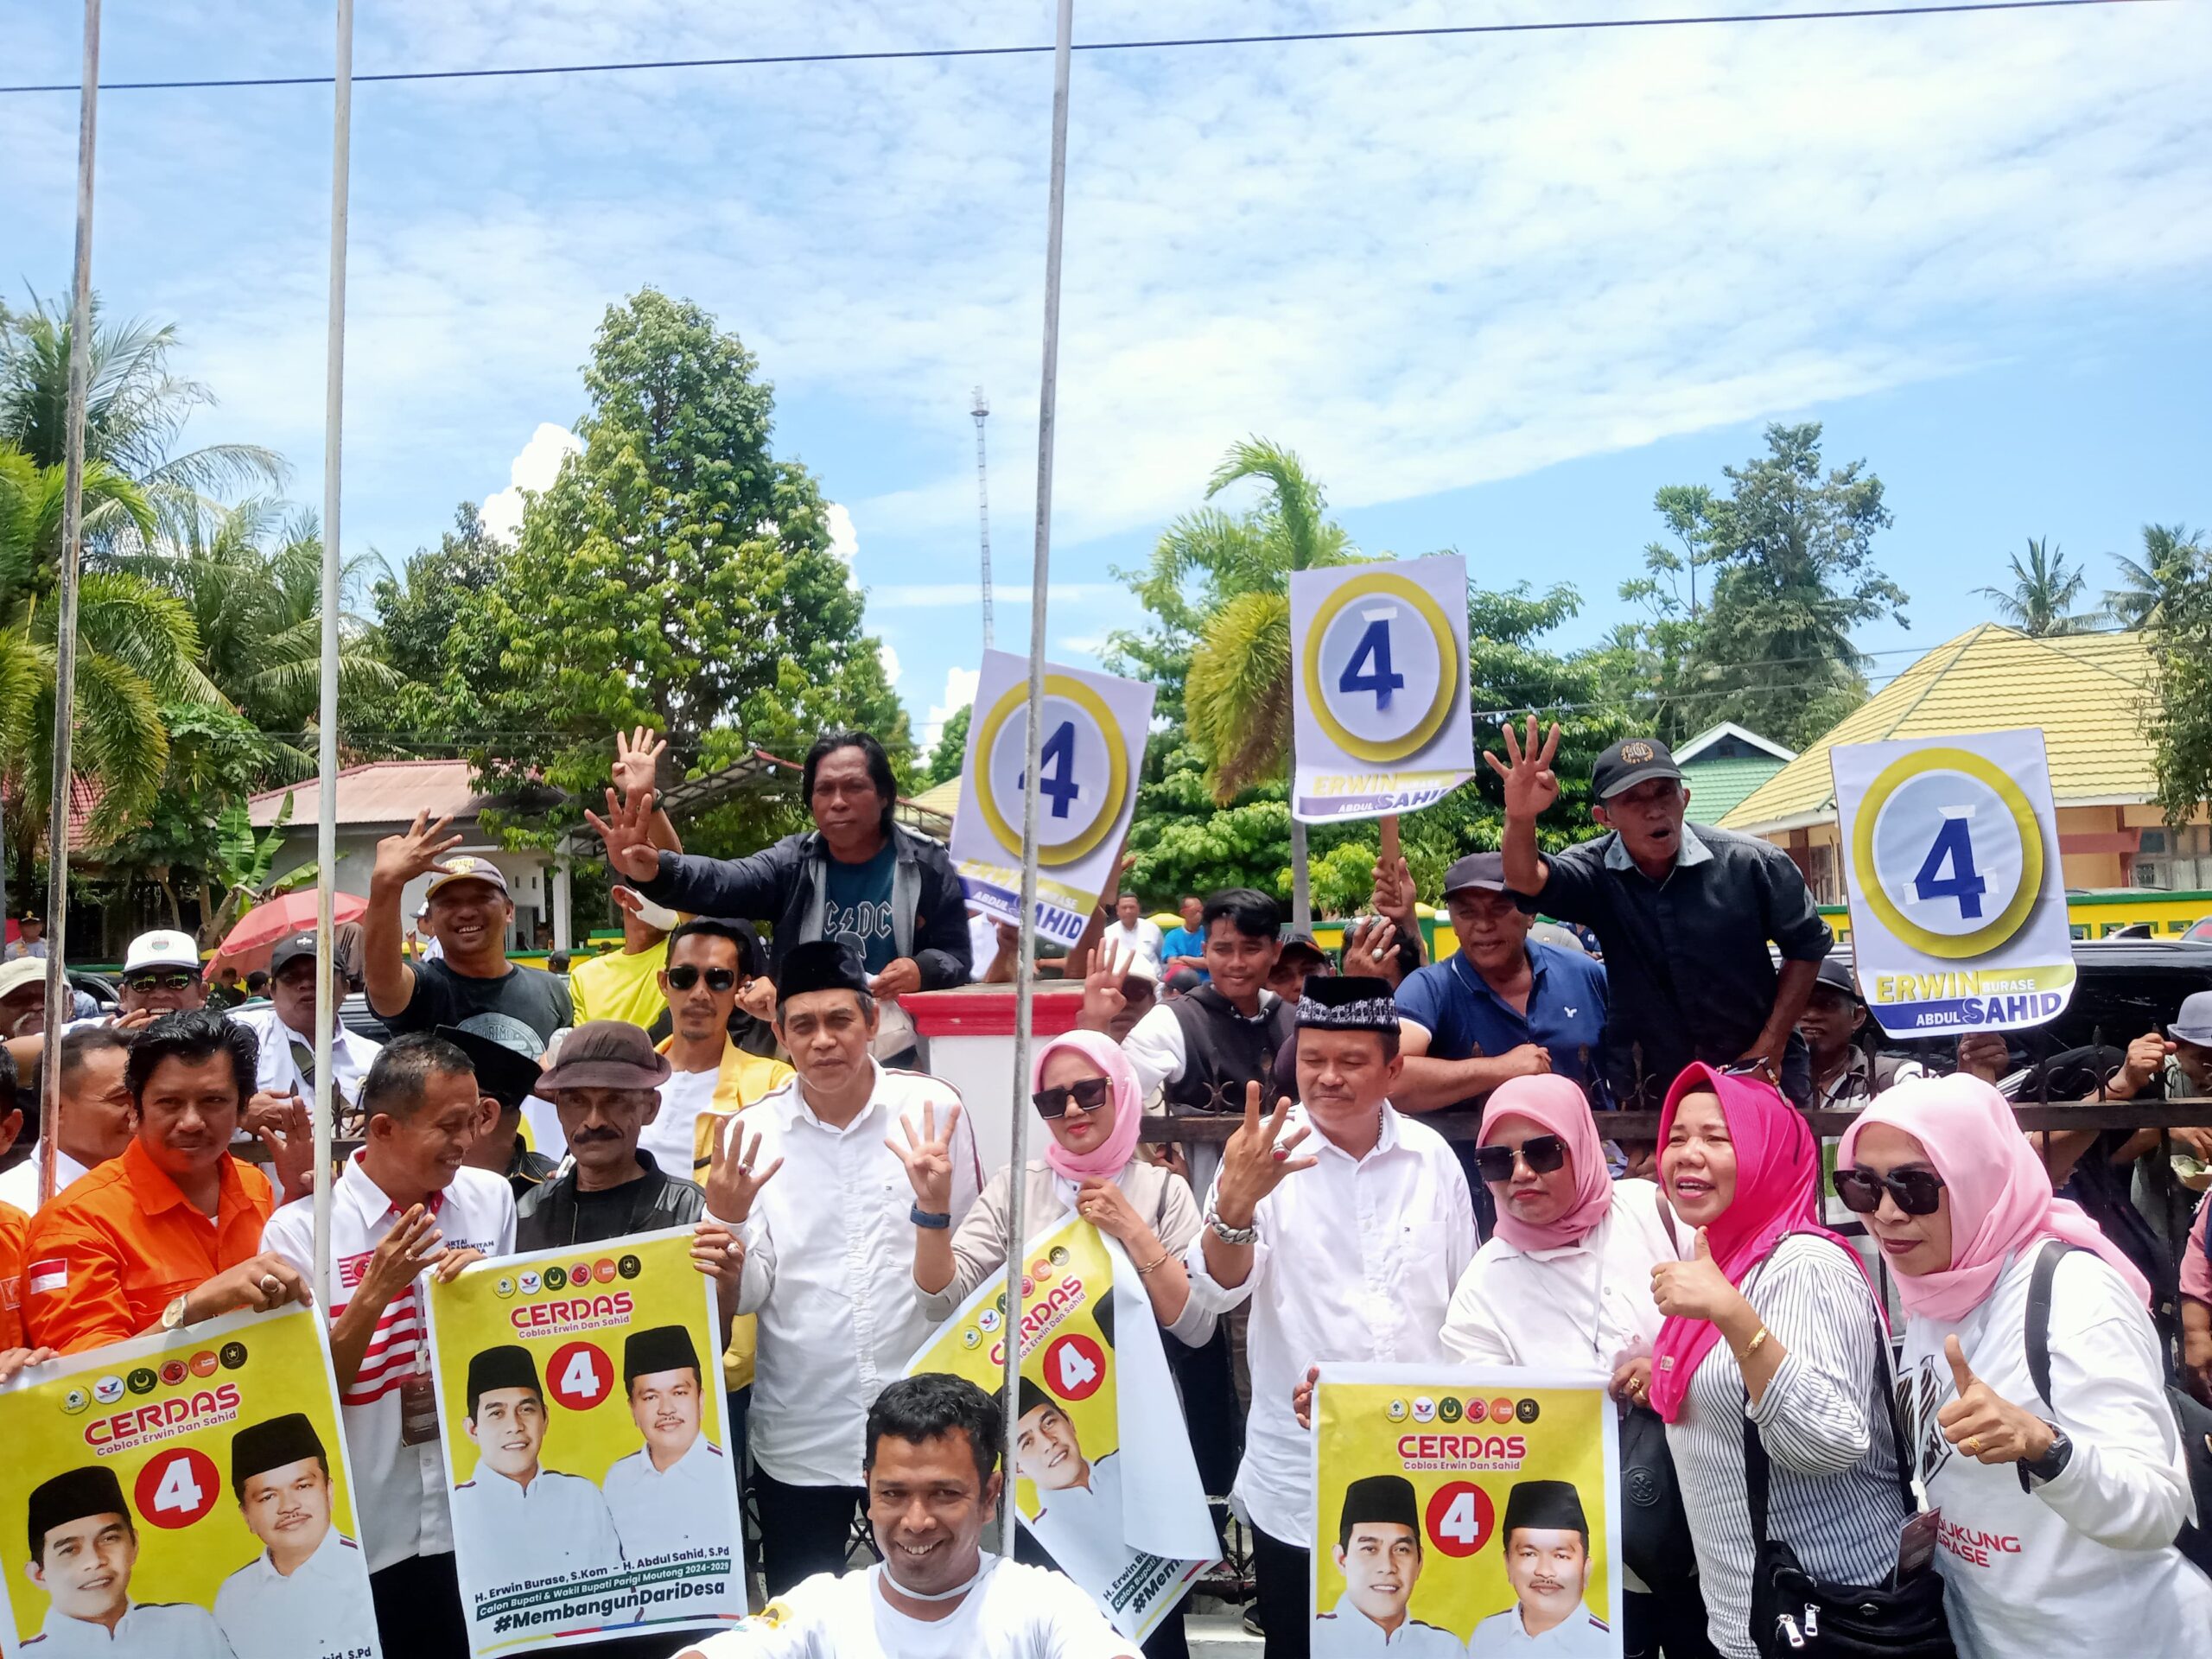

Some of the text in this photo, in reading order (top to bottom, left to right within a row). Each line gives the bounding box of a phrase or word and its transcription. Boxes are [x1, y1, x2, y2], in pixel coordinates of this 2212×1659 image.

[1339, 620, 1404, 711] 4
[1018, 721, 1079, 818] 4
[1313, 773, 1397, 796] ERWIN
[1338, 803, 1373, 814] ABDUL
[1915, 817, 1986, 918] 4
[973, 891, 1083, 939] ABDUL AHID
[1876, 971, 2036, 1003] ERWIN BURASE
[1916, 993, 2062, 1027] ABDUL SAHID
[447, 1238, 467, 1247] ARTAI
[511, 1292, 633, 1328] CERDAS
[518, 1315, 630, 1338] Coblos Erwin Dan Sahid
[990, 1274, 1083, 1365] CRDAS
[1032, 1326, 1051, 1347] Erwin
[1049, 1313, 1065, 1328] Dan
[1064, 1293, 1086, 1314] Sahid
[560, 1351, 601, 1398] 4
[1058, 1342, 1097, 1391] 4
[85, 1383, 240, 1445] CERDAS
[97, 1410, 237, 1456] Coblos Erwin Dan Sahid
[1397, 1435, 1527, 1459] CERDAS
[1404, 1460, 1520, 1470] Coblos Erwin Dan Sahid
[153, 1458, 203, 1513] 4
[1439, 1492, 1479, 1544] 4
[474, 1592, 487, 1604] H.
[489, 1582, 523, 1599] Erwin
[524, 1574, 569, 1591] Burase,
[570, 1567, 608, 1581] S.Kom
[623, 1561, 635, 1572] H.
[637, 1554, 671, 1568] Abdul
[672, 1548, 708, 1561] Sahid,
[709, 1546, 729, 1557] S.Pd
[479, 1601, 509, 1617] Calon
[511, 1593, 542, 1609] Bupati
[553, 1586, 580, 1599] Wakil
[581, 1580, 612, 1595] Bupati
[613, 1573, 641, 1587] Parigi
[642, 1567, 683, 1581] Moutong
[684, 1561, 729, 1574] 2024-2029
[1103, 1589, 1115, 1601] H.
[1112, 1563, 1137, 1590] Erwin
[1115, 1585, 1135, 1609] Calon
[493, 1581, 725, 1634] #MembangunDariDesa
